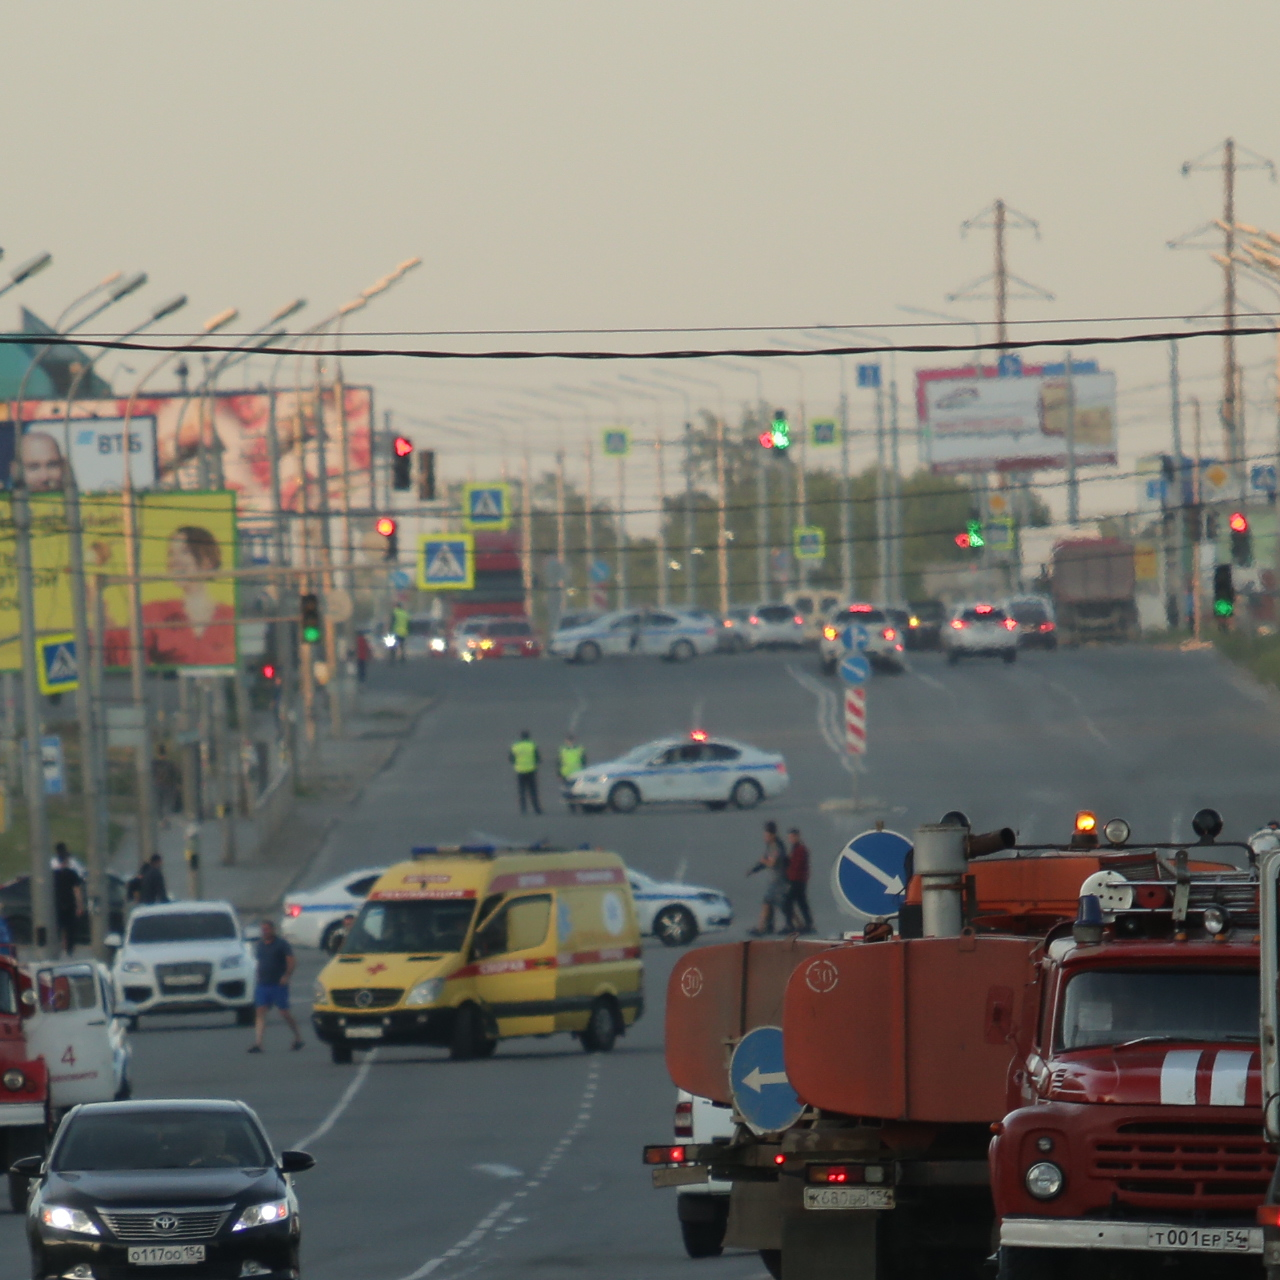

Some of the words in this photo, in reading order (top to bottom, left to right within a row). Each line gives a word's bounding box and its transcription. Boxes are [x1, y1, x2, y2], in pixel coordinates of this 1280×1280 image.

[813, 968, 833, 985] 30
[60, 1044, 77, 1066] 4
[1155, 1229, 1221, 1246] Т001ЕР
[1225, 1230, 1245, 1244] 54
[131, 1247, 182, 1261] О117ОО
[183, 1245, 204, 1258] 154
